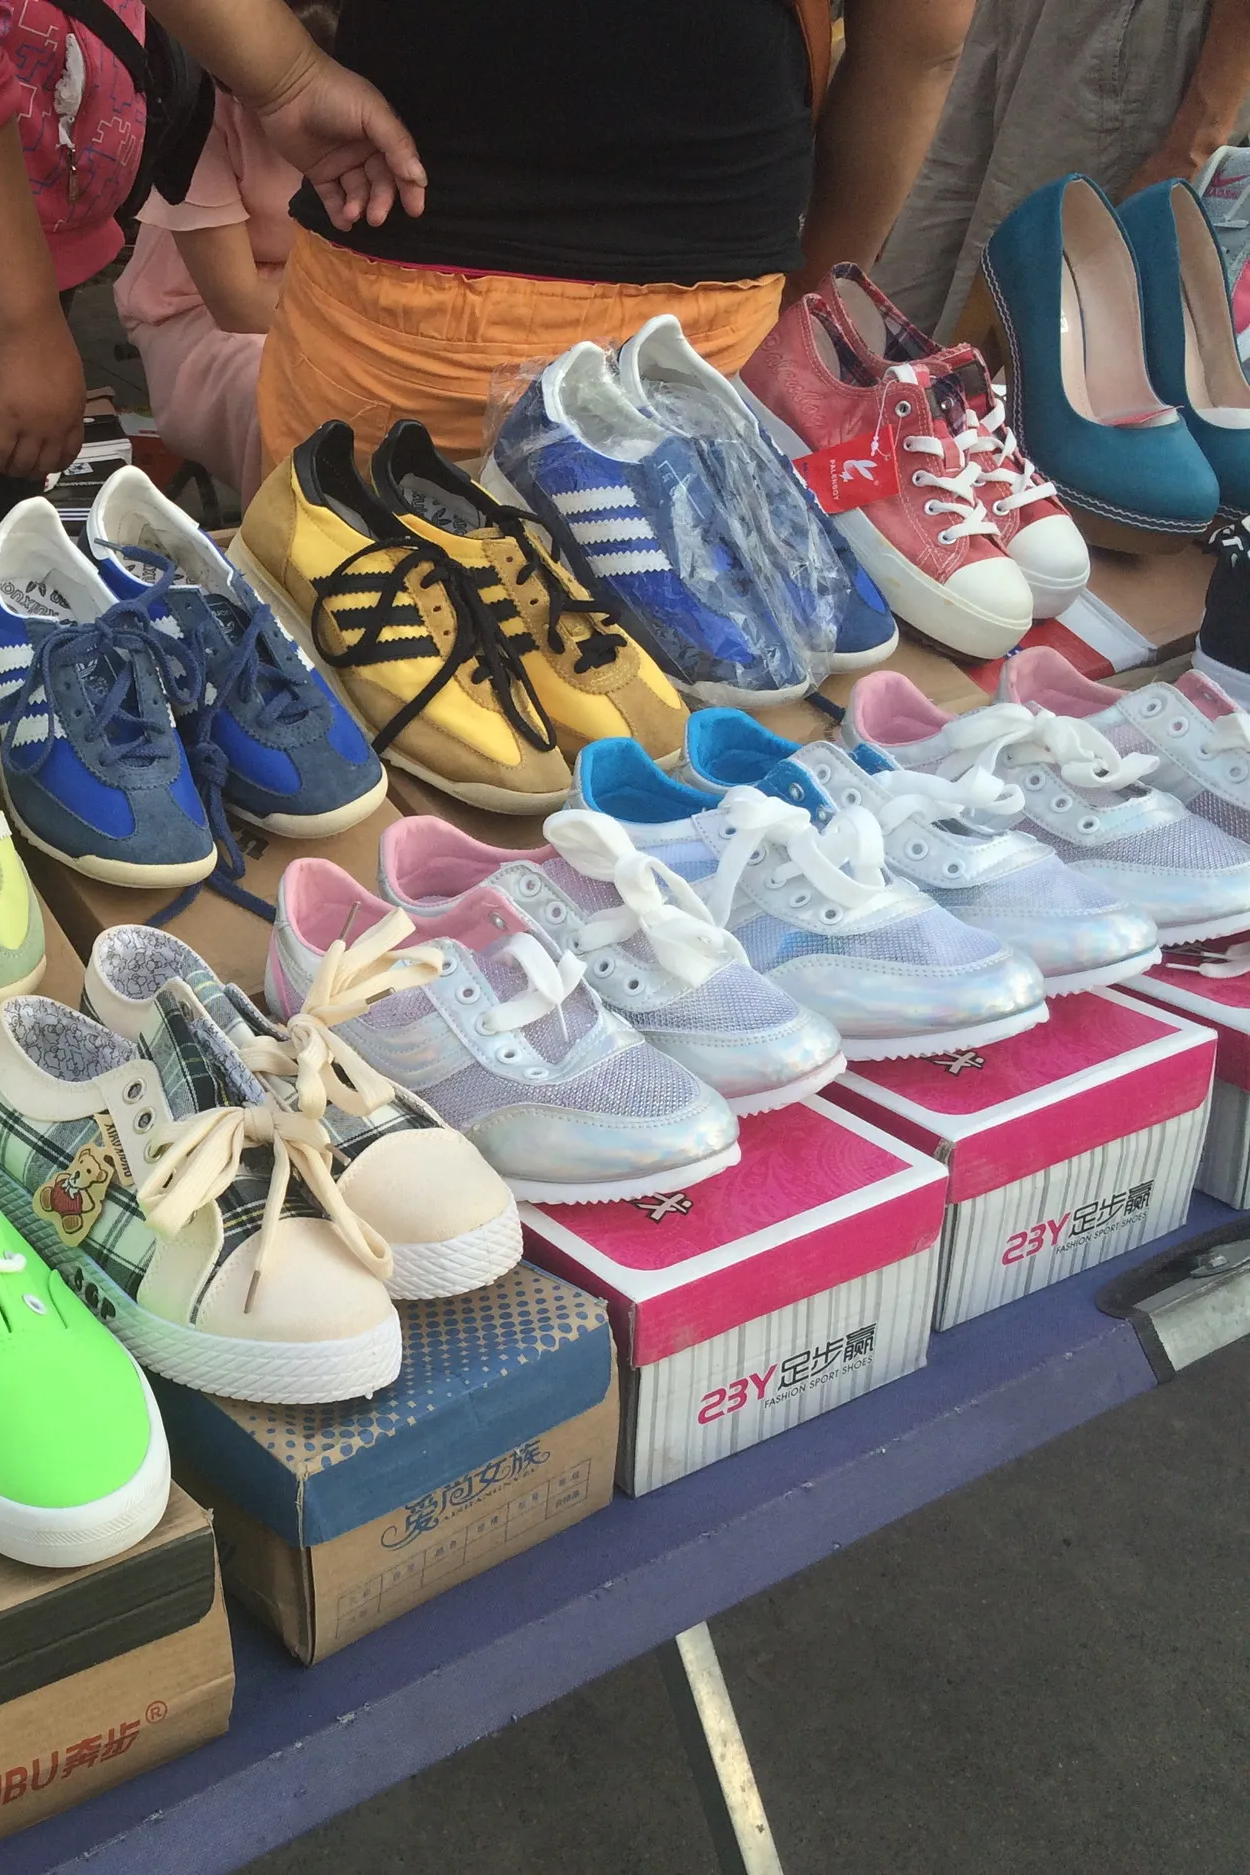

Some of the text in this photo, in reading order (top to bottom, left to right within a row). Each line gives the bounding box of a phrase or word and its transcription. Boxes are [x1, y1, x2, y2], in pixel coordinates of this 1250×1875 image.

[1001, 1179, 1155, 1266] 23Y 足步赢
[1055, 1212, 1148, 1255] FASHION SPORT SHOES
[697, 1322, 877, 1425] 23Y 足步赢
[764, 1356, 873, 1409] FASHION SPORT SHOES
[60, 1718, 142, 1780] 奔步
